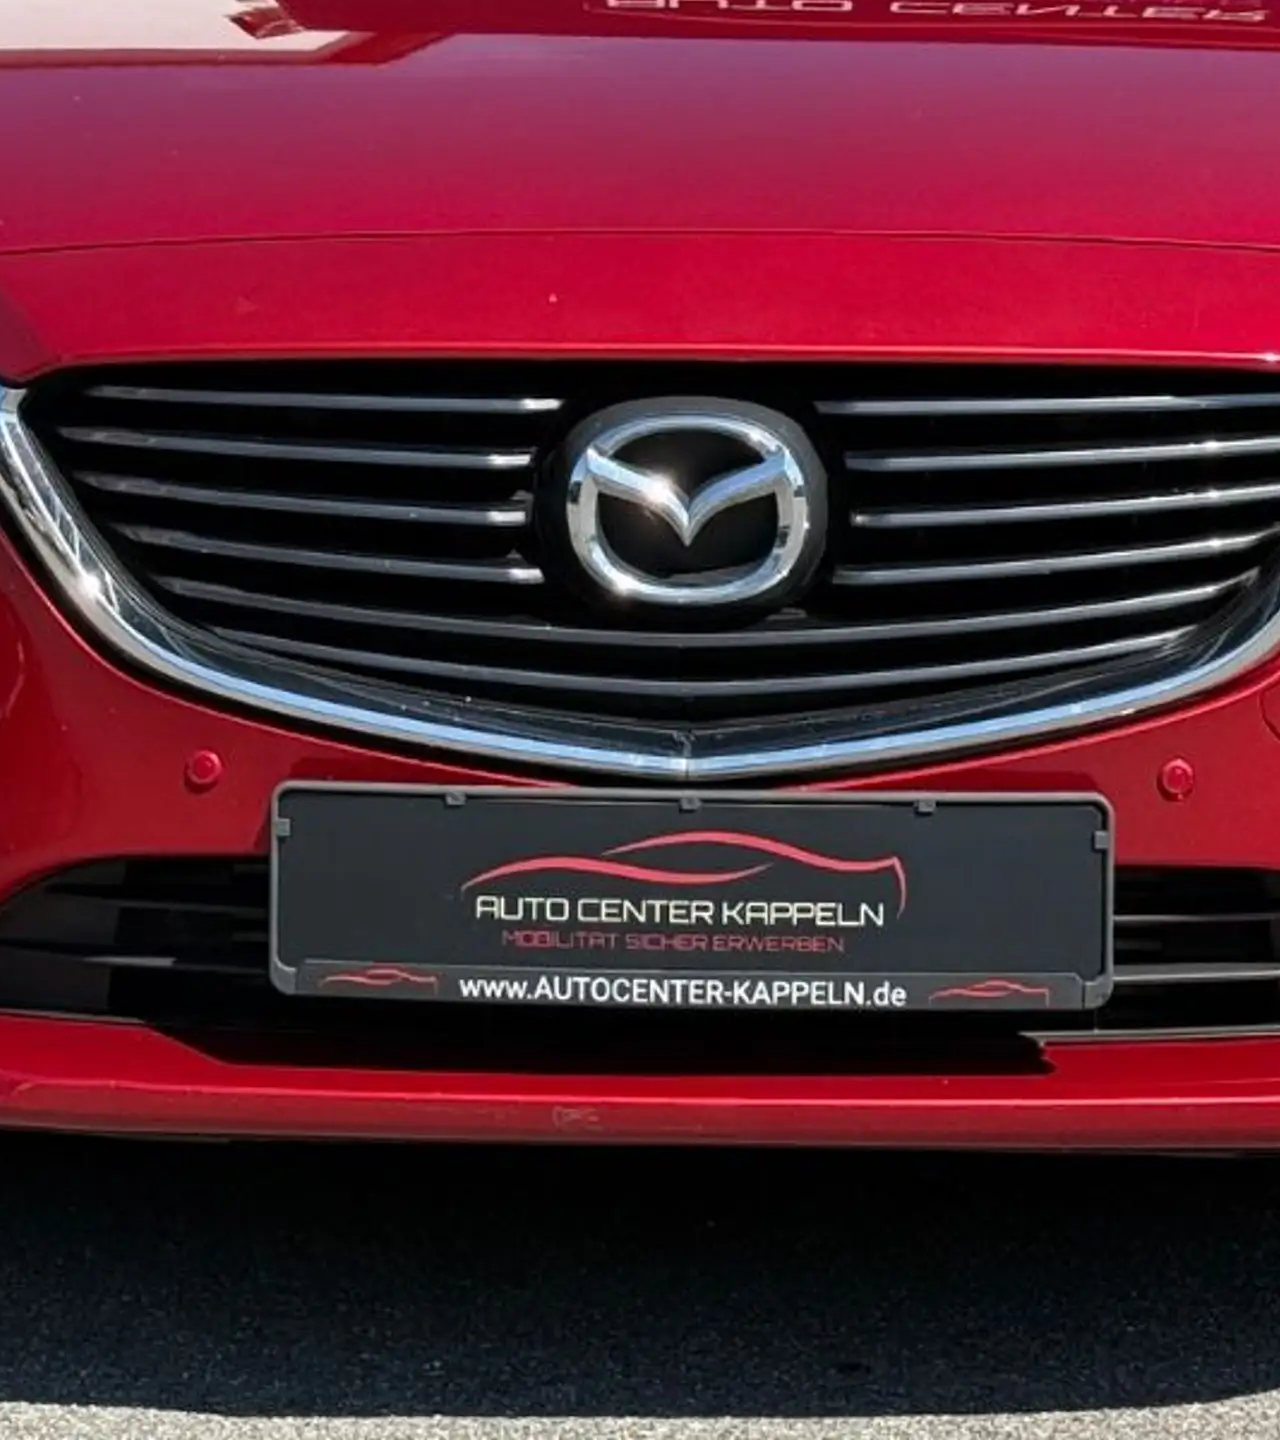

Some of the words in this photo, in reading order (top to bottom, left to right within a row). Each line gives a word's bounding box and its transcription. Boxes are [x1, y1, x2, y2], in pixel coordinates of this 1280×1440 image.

[475, 895, 569, 920] AUTO
[577, 898, 714, 925] CENTER
[722, 901, 884, 928] KAPPELN
[625, 932, 708, 951] SICHER
[713, 934, 845, 953] ERWERBEN
[459, 976, 907, 1007] www.AUTOCENTER-KAPPELN.de
